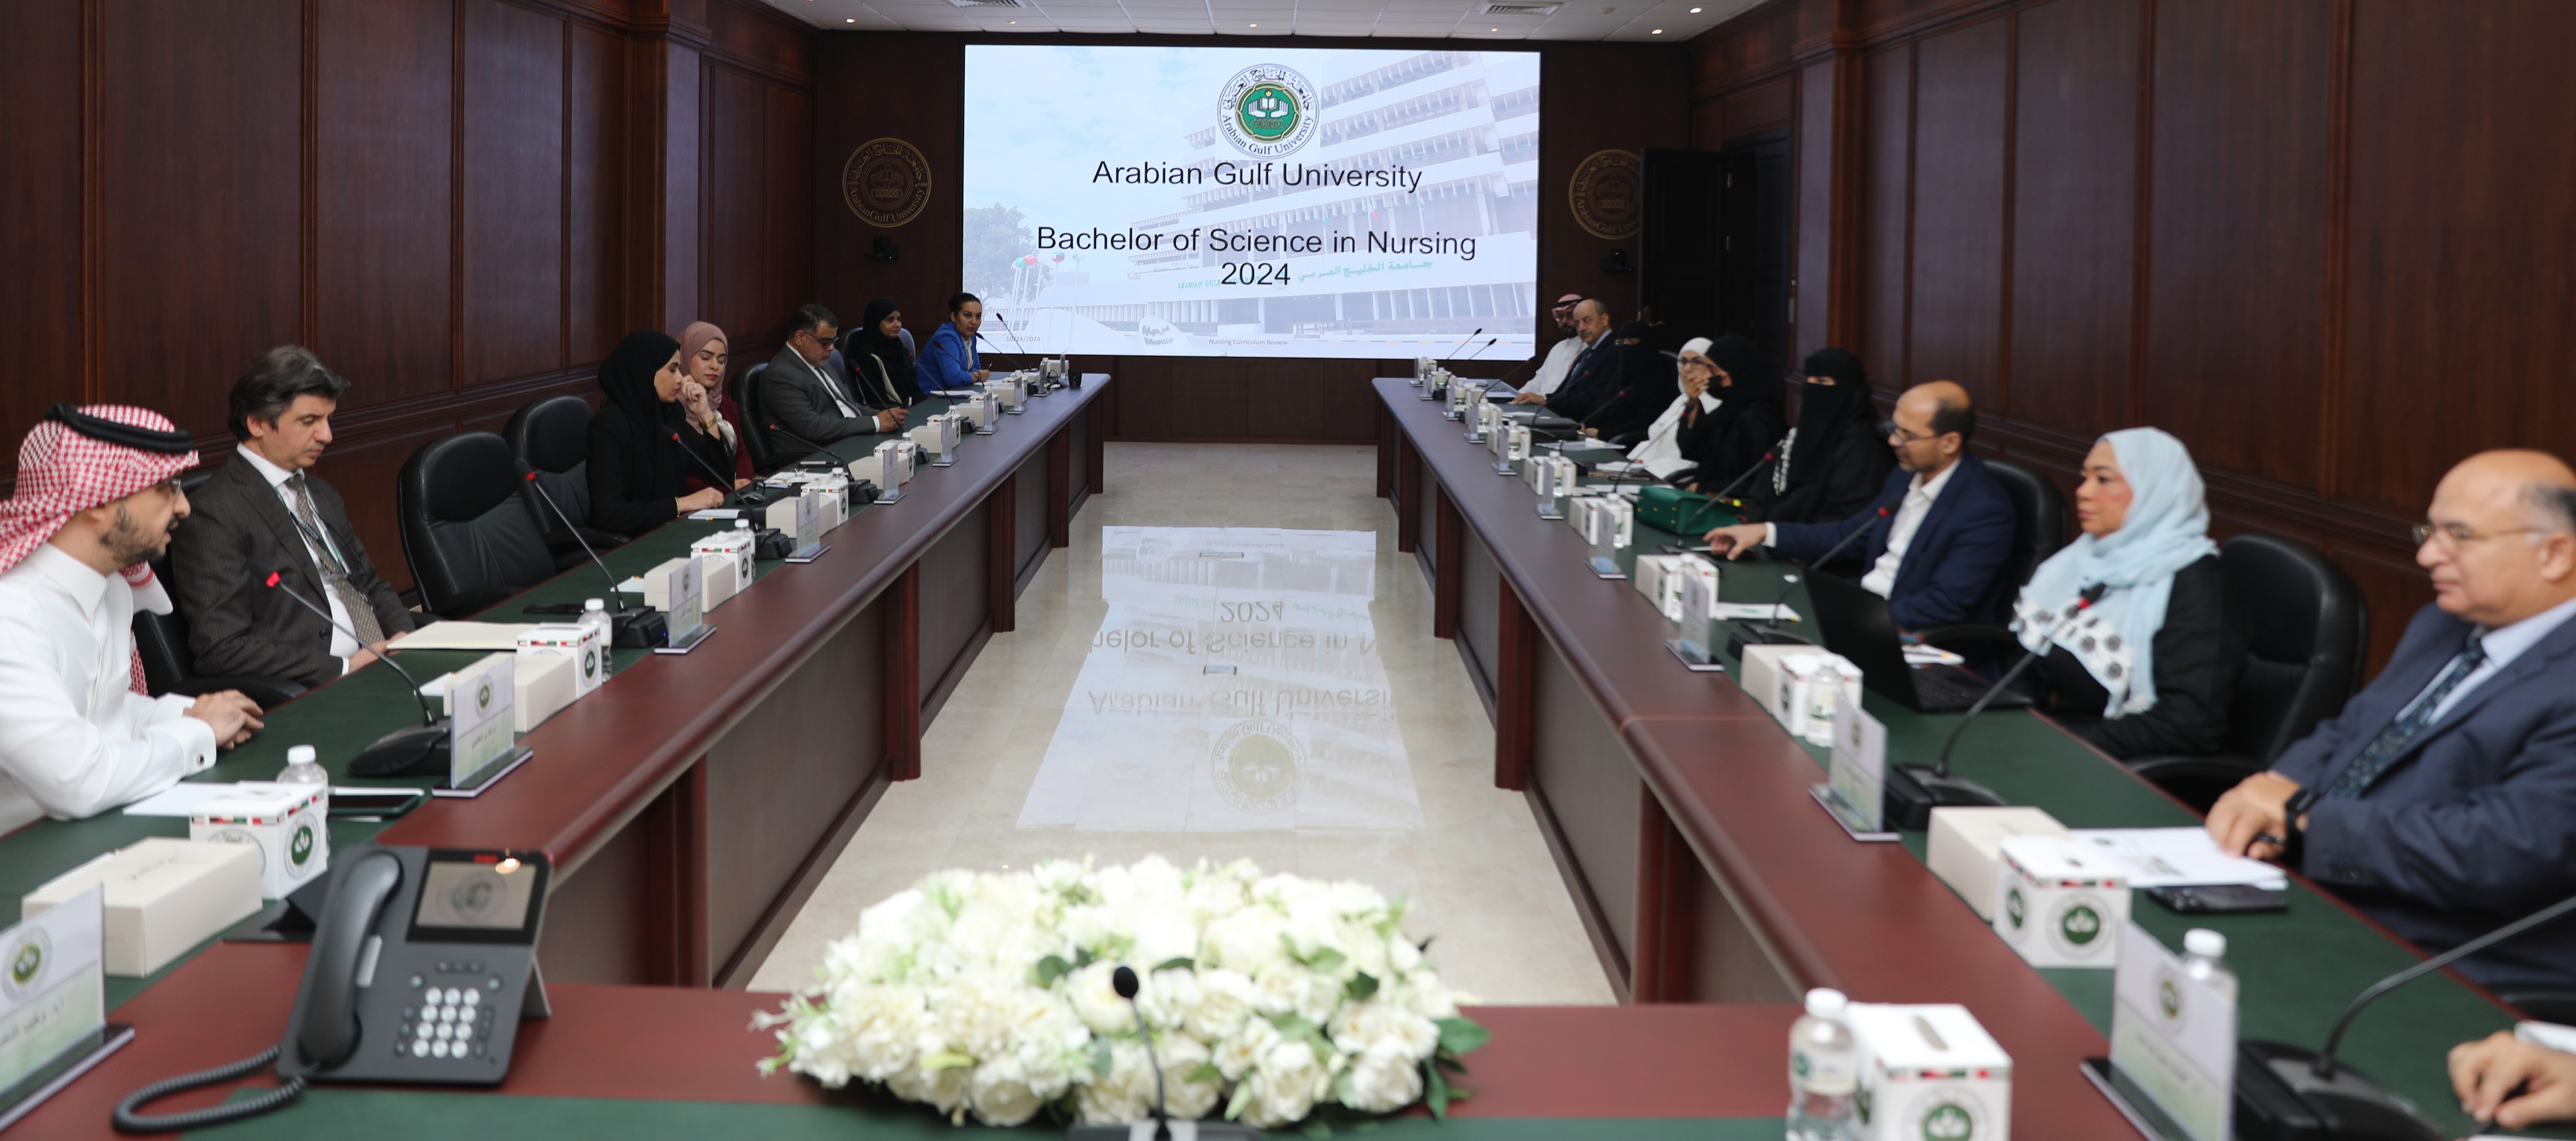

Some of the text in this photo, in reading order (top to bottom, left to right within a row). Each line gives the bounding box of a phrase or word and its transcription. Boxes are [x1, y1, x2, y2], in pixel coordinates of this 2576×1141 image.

[1222, 115, 1314, 155] Arabian Gulf University
[1092, 161, 1422, 194] Arabian Gulf University
[850, 187, 925, 222] Arabian Gulf University
[1038, 227, 1475, 261] Bachelor of Science in Nursing
[1221, 262, 1290, 285] 2024
